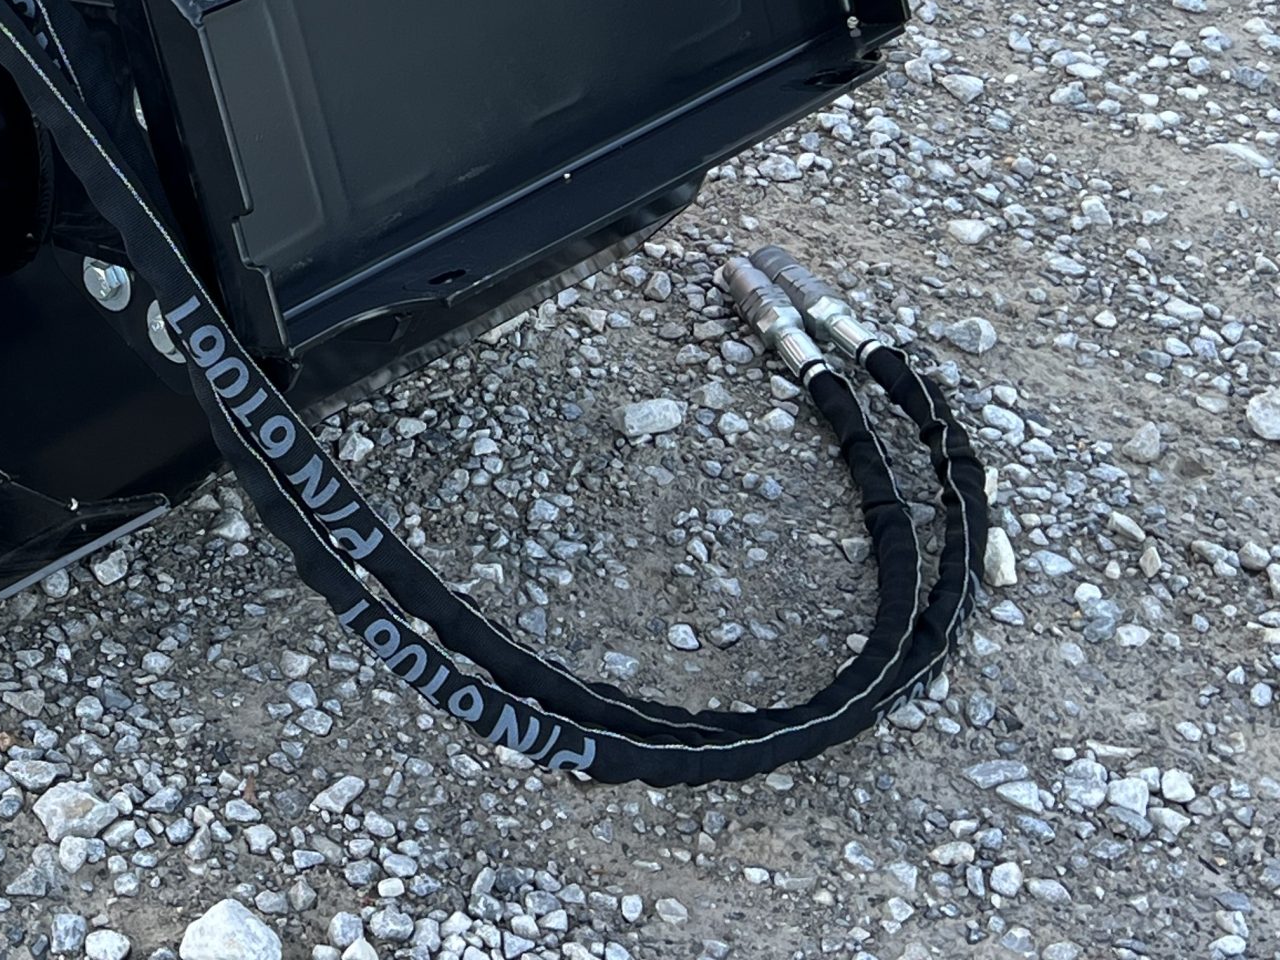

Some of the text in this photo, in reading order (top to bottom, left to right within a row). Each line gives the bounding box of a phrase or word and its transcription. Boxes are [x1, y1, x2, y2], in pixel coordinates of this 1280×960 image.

[166, 295, 384, 560] P/N 61061
[340, 599, 596, 770] P/N 61061
